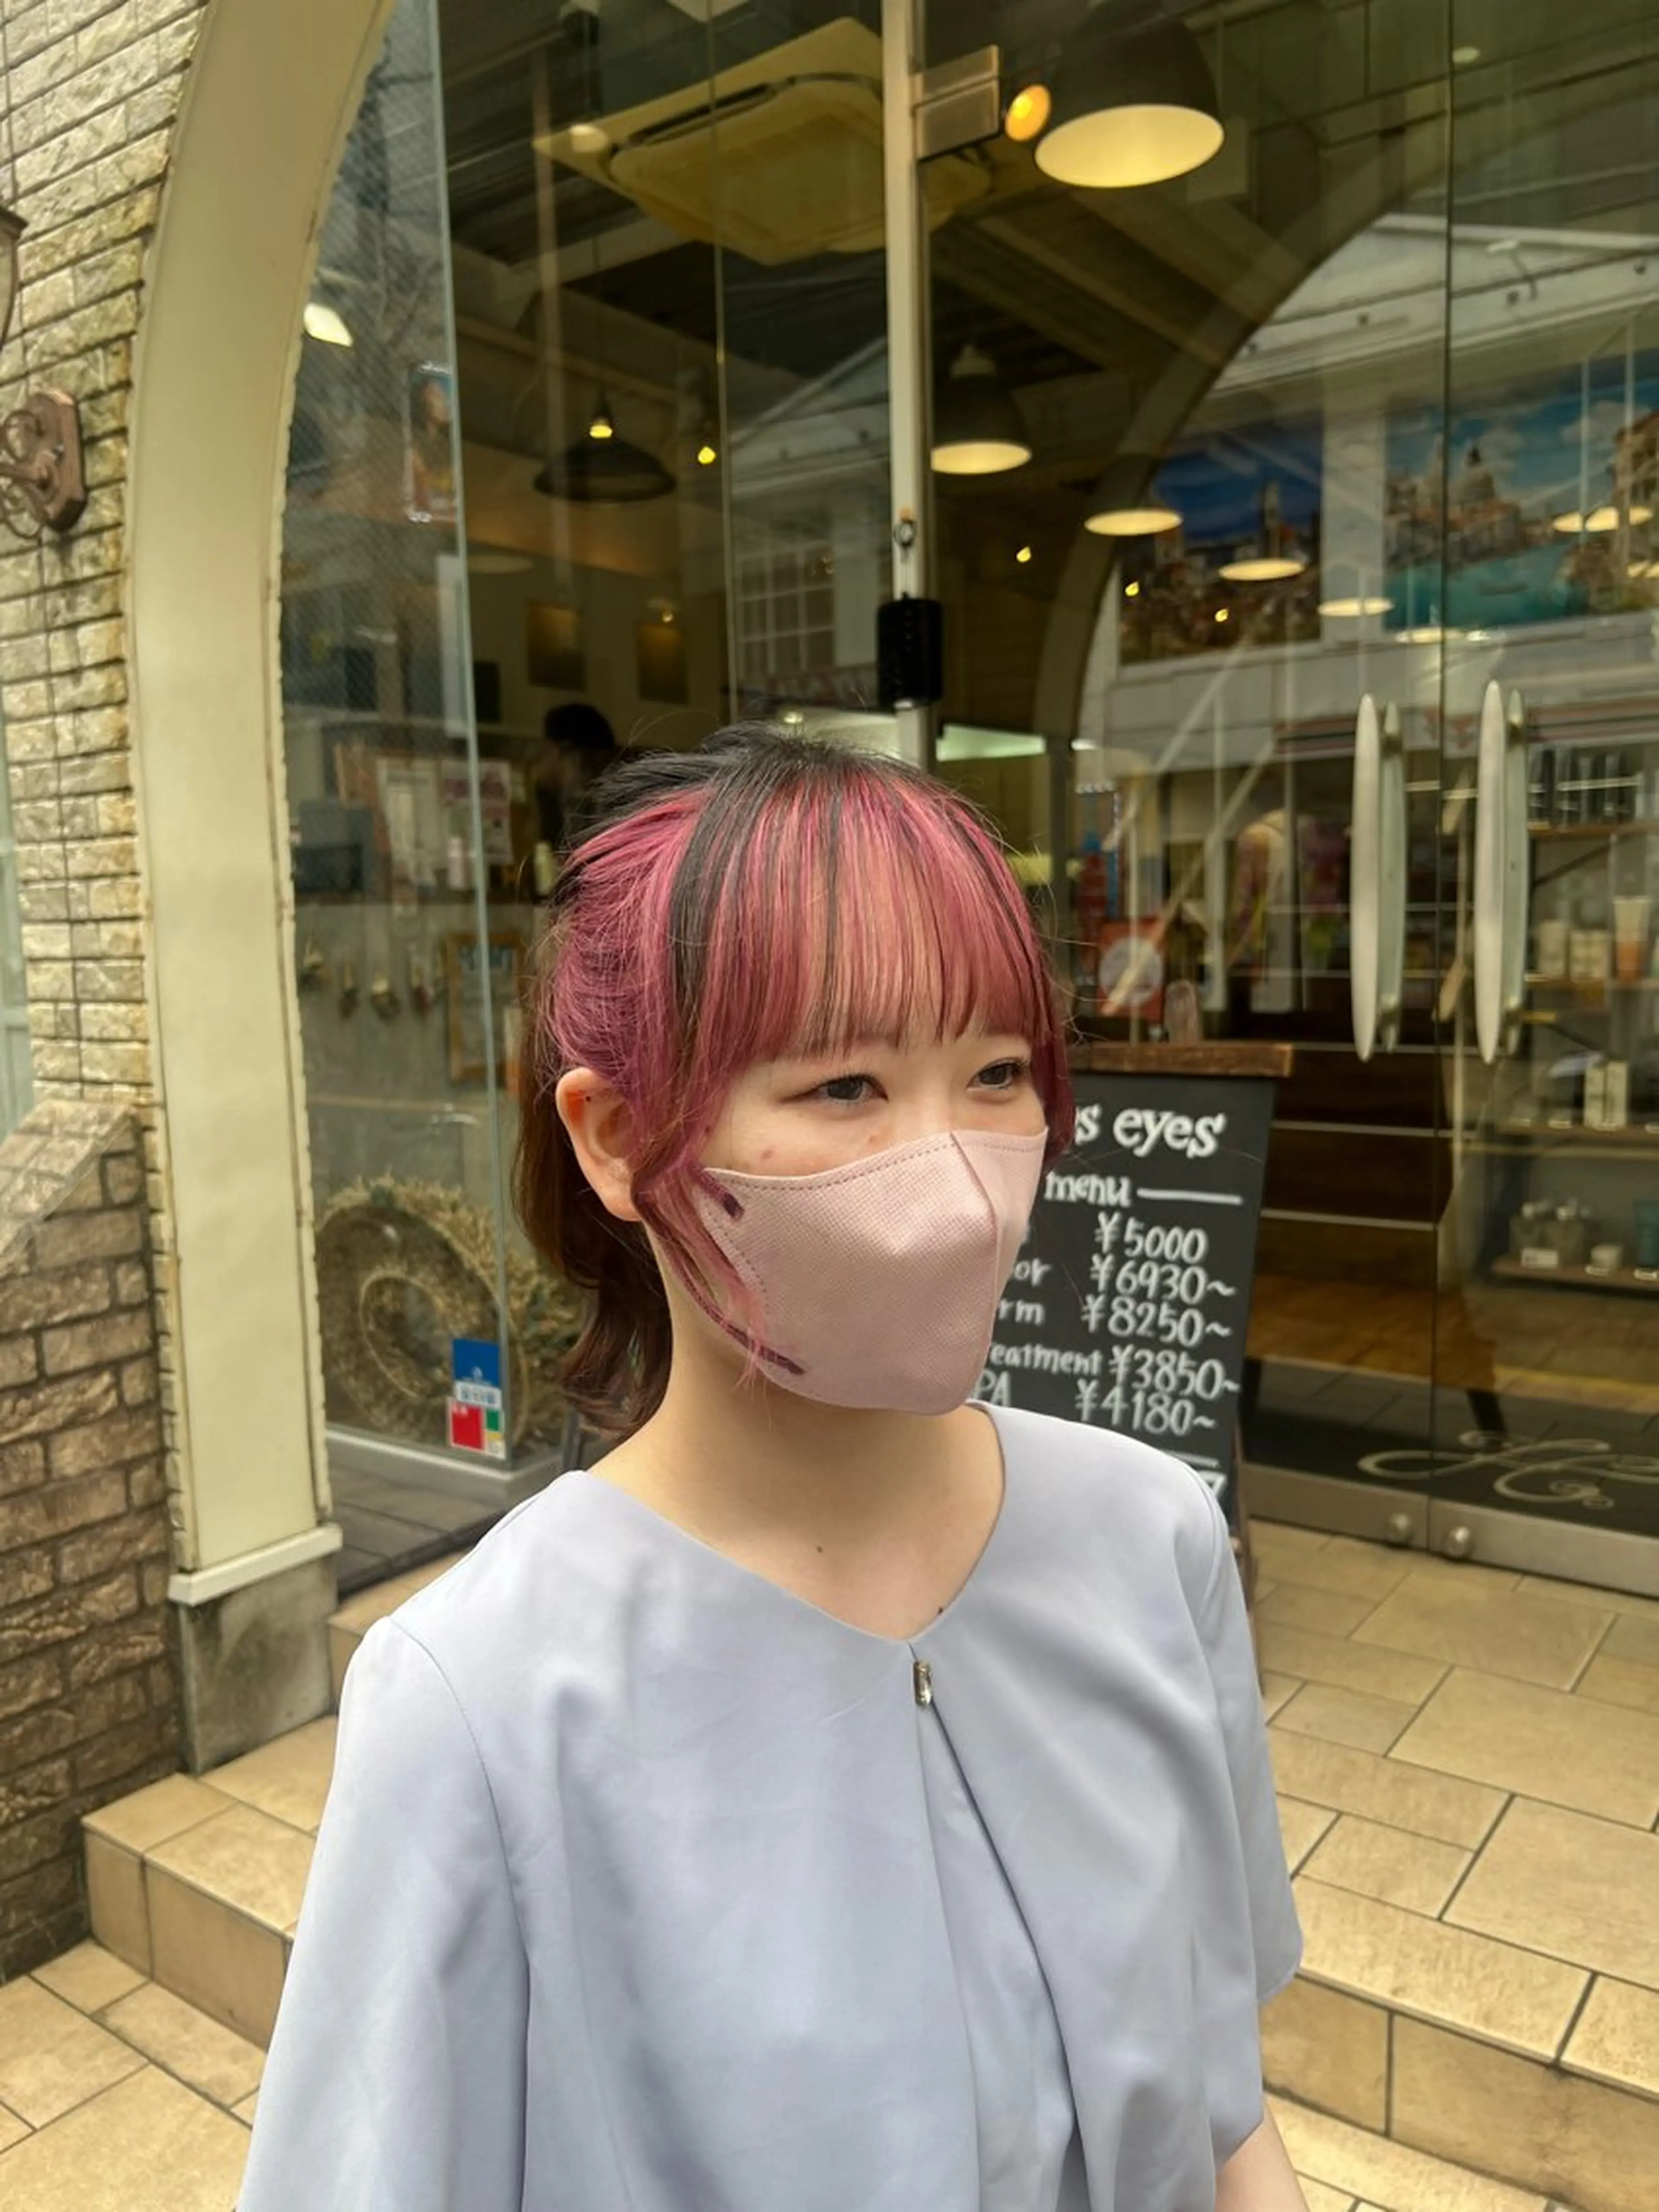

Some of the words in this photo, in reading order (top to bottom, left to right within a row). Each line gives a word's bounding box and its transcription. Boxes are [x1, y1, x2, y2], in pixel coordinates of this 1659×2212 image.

[1113, 1108, 1227, 1158] eyes
[1044, 1171, 1131, 1207] menu
[1094, 1211, 1208, 1264] ¥5000
[990, 1342, 1103, 1375] eatment
